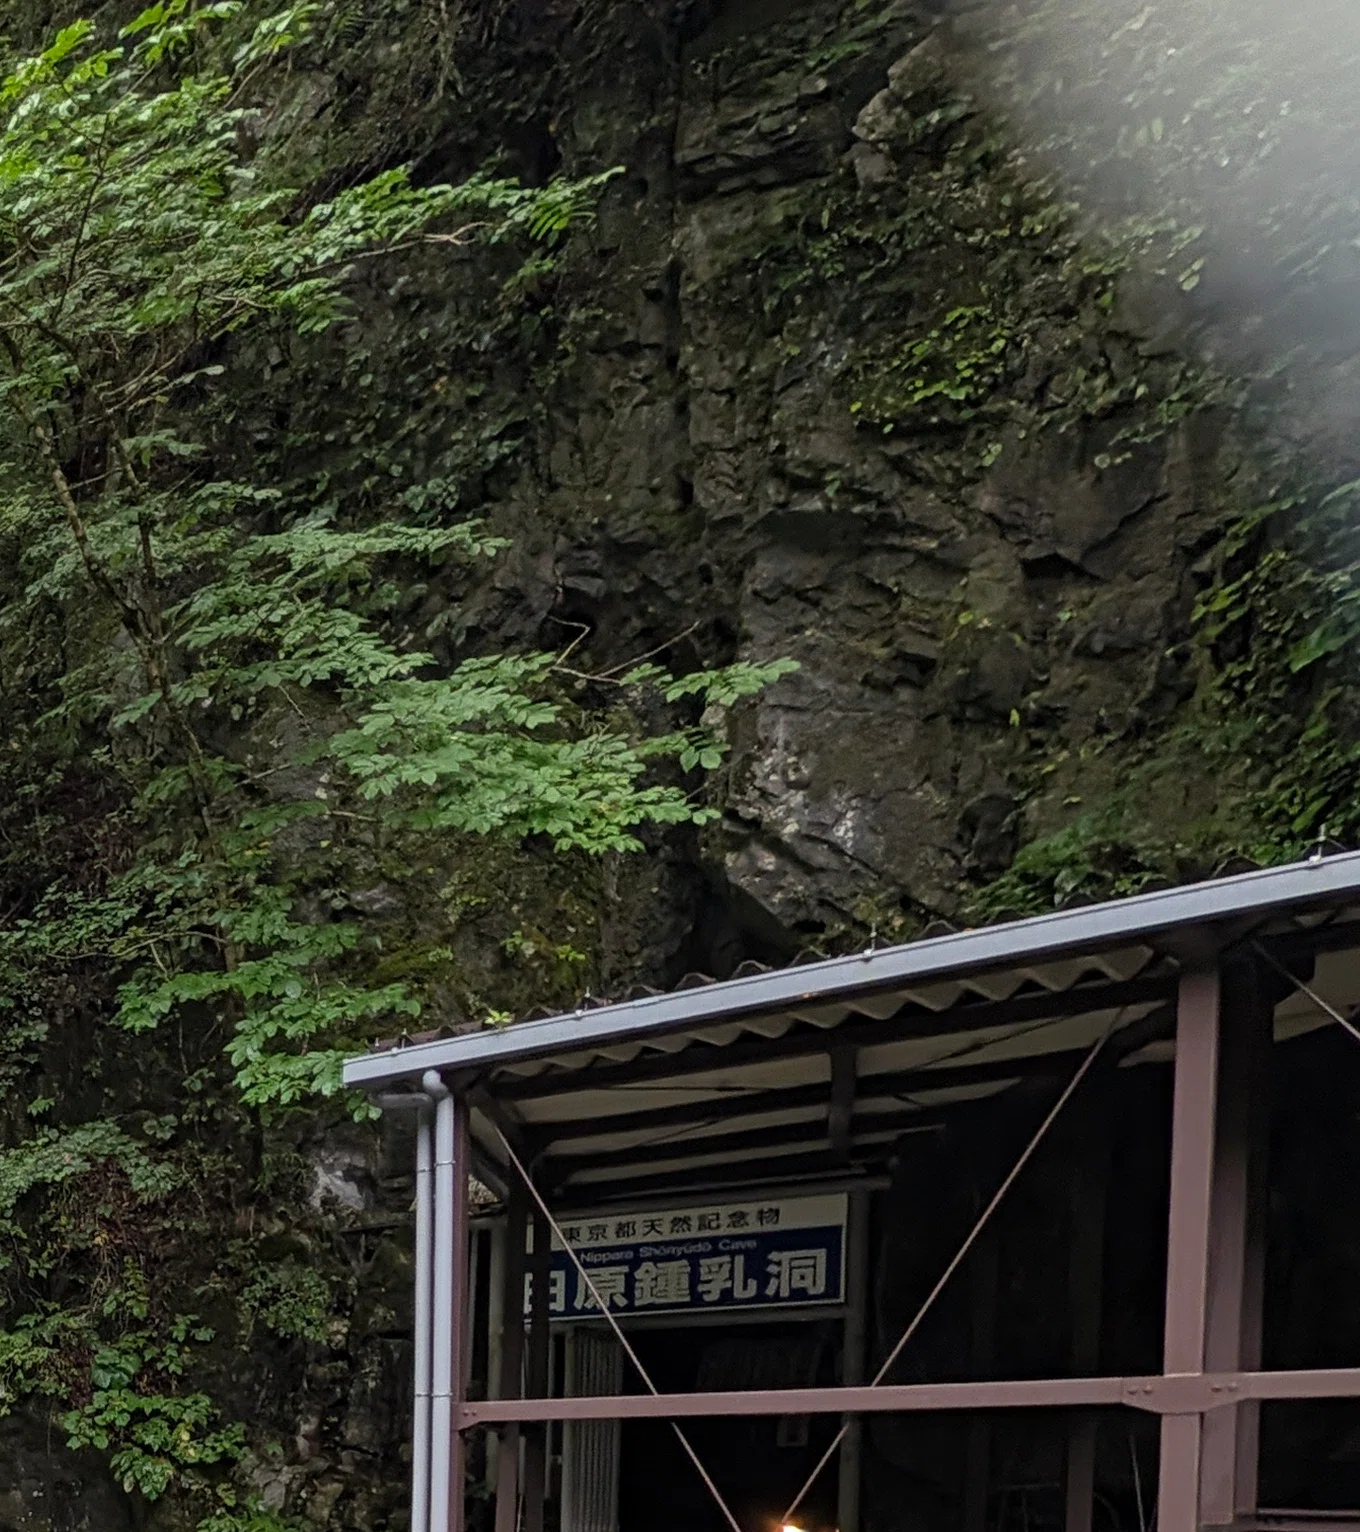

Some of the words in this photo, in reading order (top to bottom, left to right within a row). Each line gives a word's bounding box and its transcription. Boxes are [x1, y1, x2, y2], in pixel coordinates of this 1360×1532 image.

[561, 1208, 781, 1243] 東京都天然記念物
[581, 1250, 634, 1264] Nippara
[718, 1238, 757, 1251] Cave
